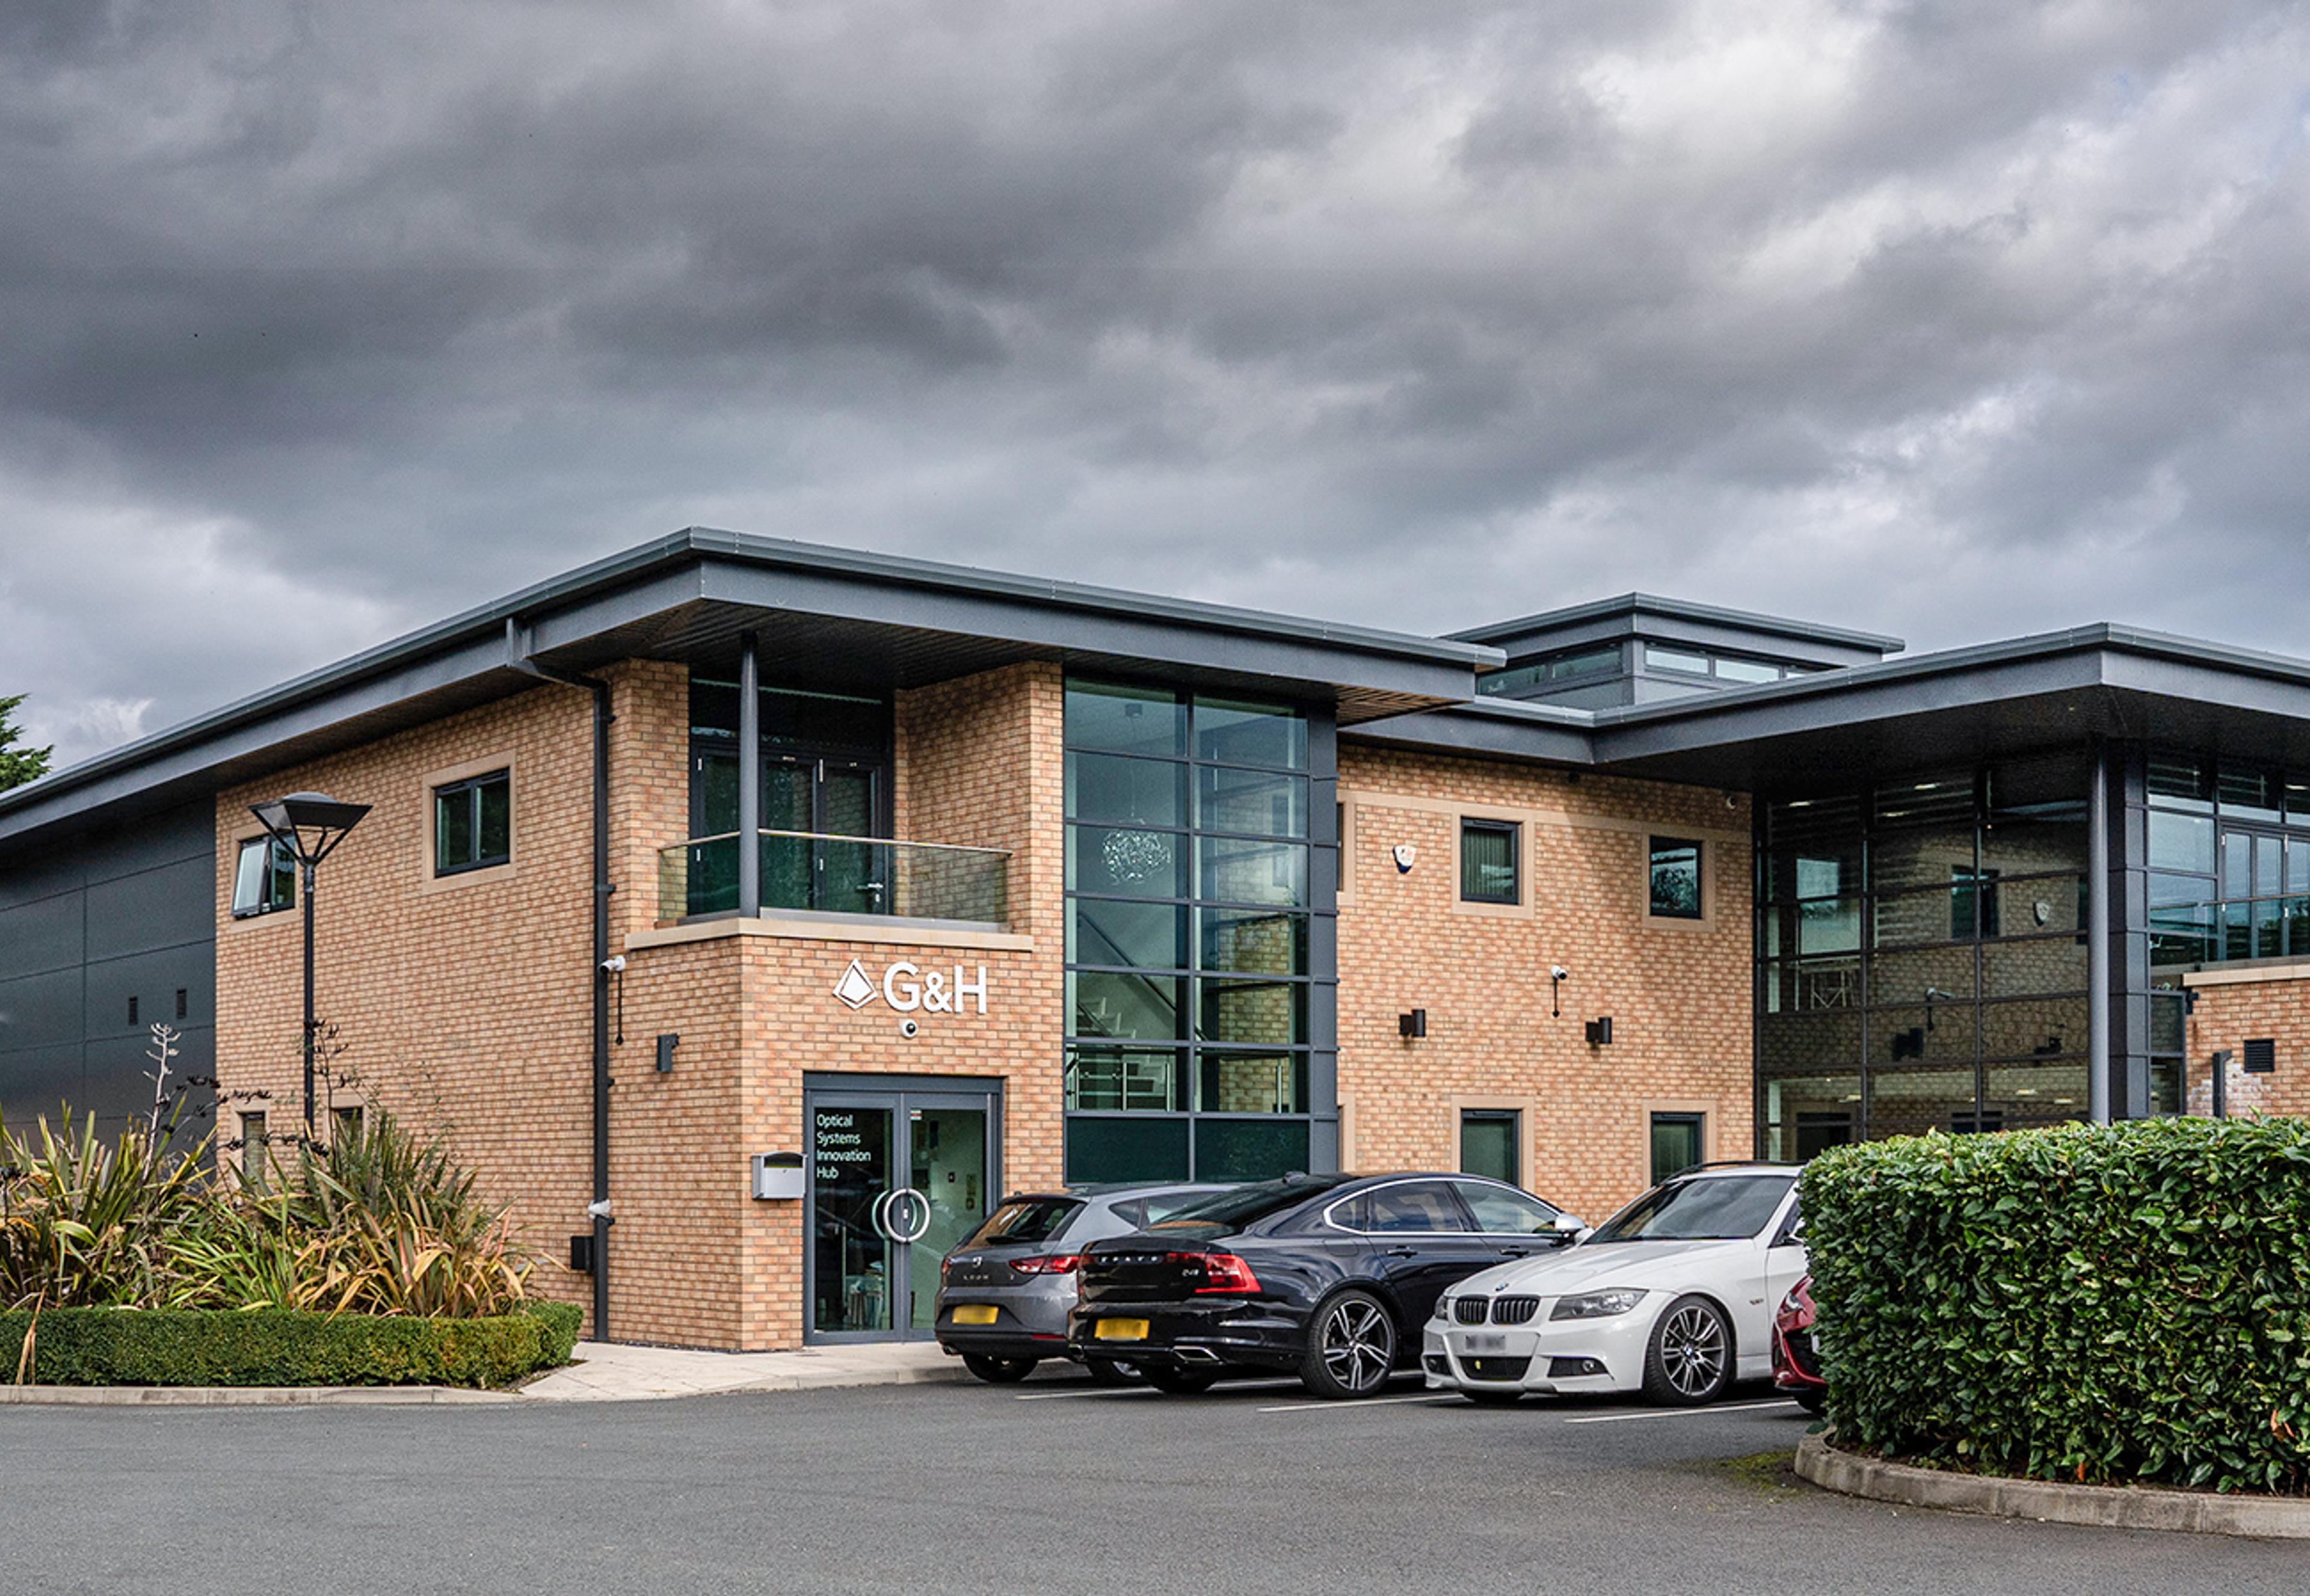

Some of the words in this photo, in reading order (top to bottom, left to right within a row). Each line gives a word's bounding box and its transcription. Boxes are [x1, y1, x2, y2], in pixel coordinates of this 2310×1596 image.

[882, 961, 988, 1014] G&H
[817, 1114, 853, 1129] Optical
[817, 1131, 861, 1147] Systems
[817, 1149, 871, 1161] Innovation
[817, 1166, 839, 1179] Hub
